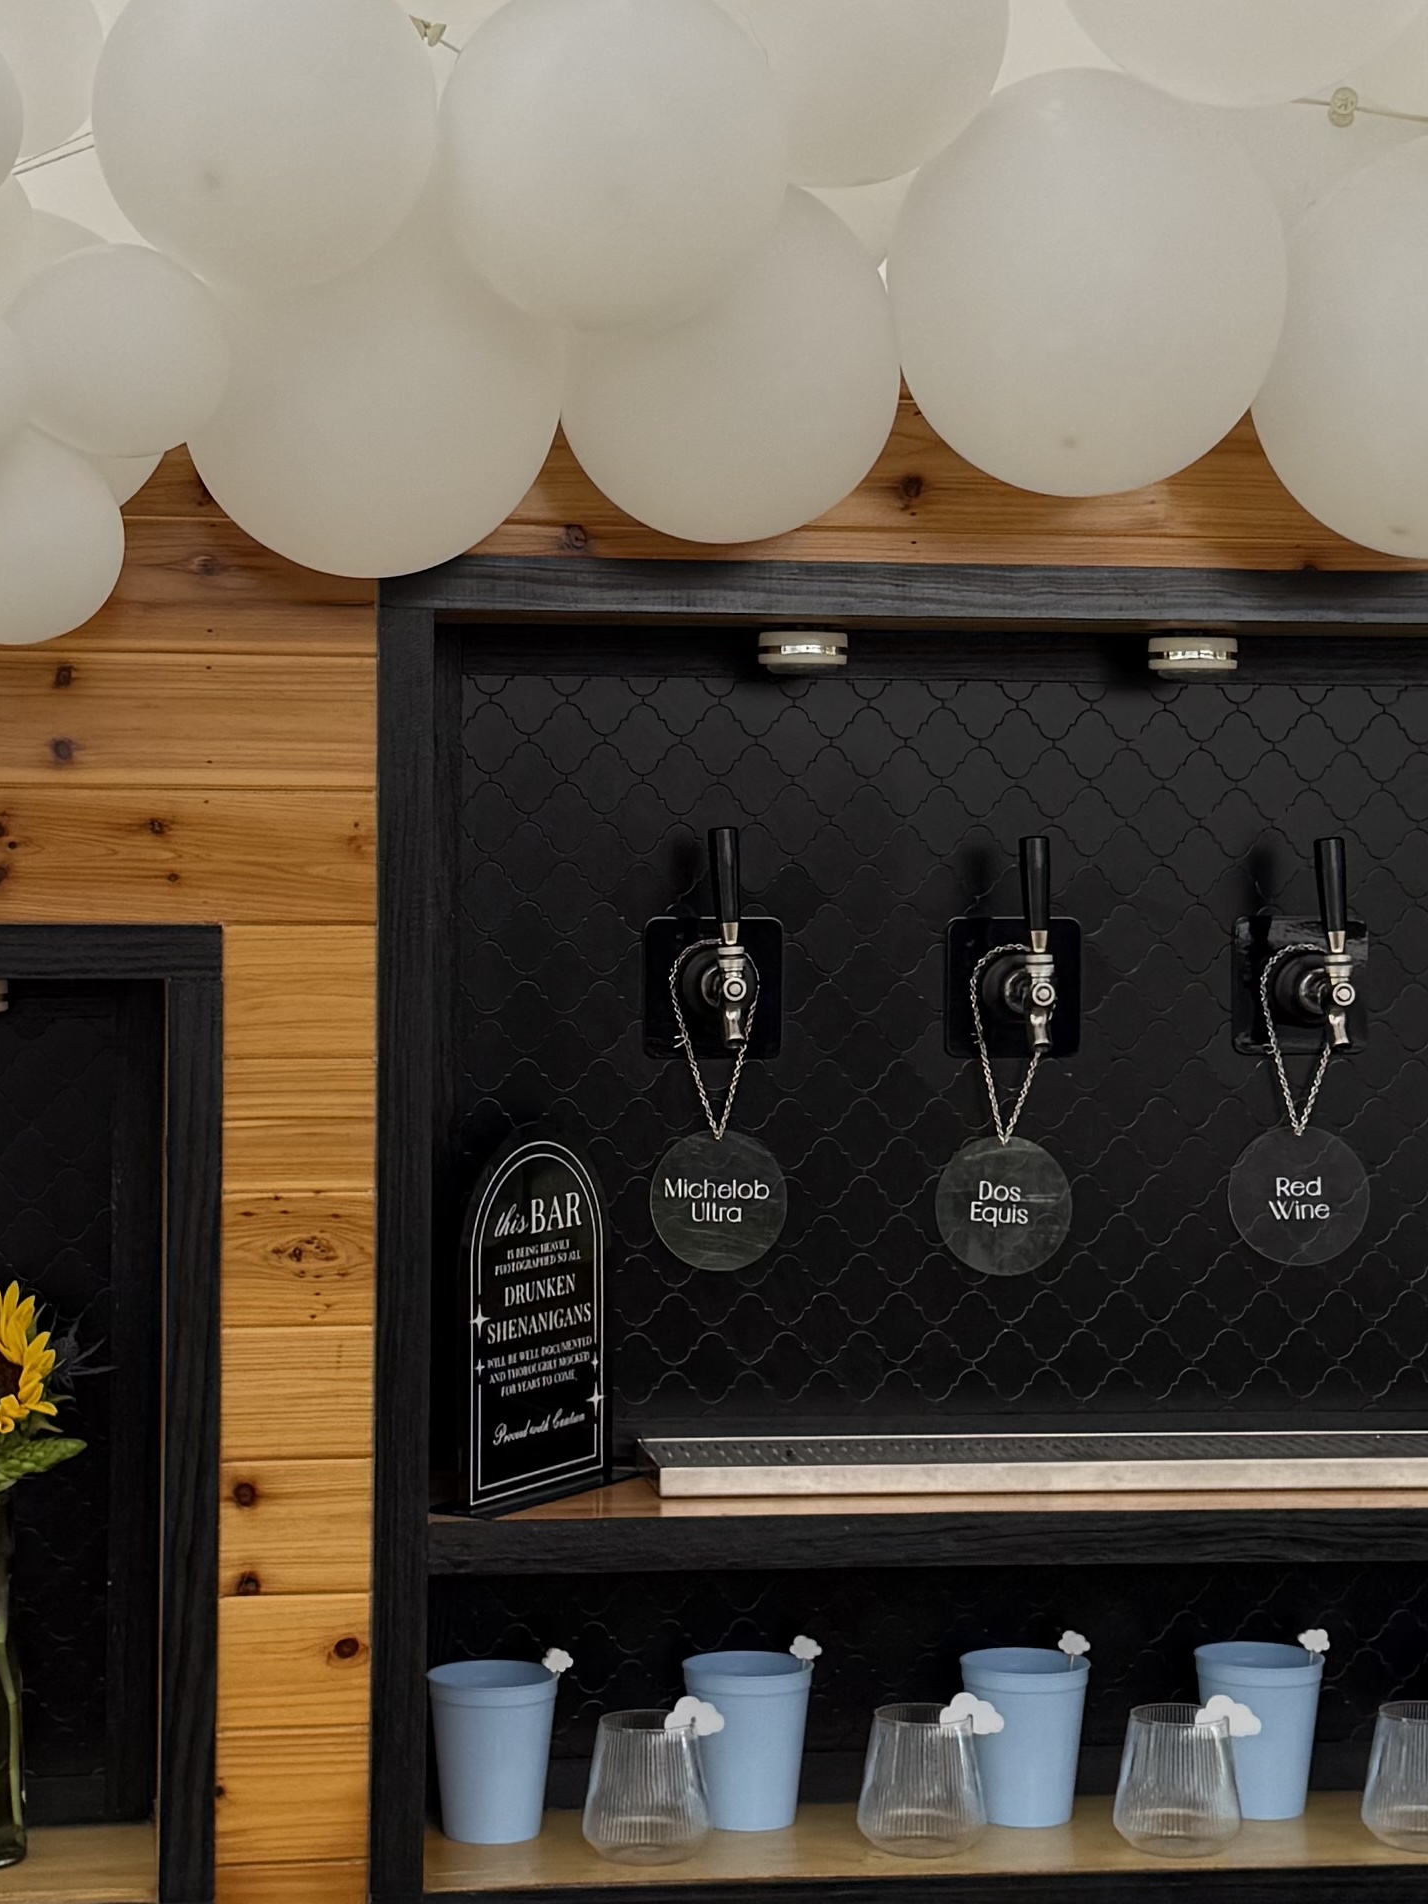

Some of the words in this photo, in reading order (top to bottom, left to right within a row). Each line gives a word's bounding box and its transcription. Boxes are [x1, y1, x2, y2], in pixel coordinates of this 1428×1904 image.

[664, 1178, 770, 1200] Michelob
[978, 1180, 1021, 1202] Dos
[1276, 1176, 1321, 1196] Red
[494, 1203, 529, 1237] this
[531, 1192, 582, 1234] BAR
[691, 1201, 742, 1223] Ultra
[969, 1201, 1029, 1226] Equis
[1269, 1201, 1330, 1220] Wine
[494, 1256, 556, 1276] PHOTOGRAPHED
[504, 1273, 576, 1307] DRUNKEN
[487, 1302, 591, 1344] SHENANIGANS
[487, 1356, 506, 1369] WILL
[508, 1353, 517, 1365] BE
[519, 1348, 539, 1361] WELL
[541, 1335, 592, 1357] DOCUMENTED
[489, 1371, 506, 1384] AND
[507, 1359, 557, 1381] THOROUGHLY
[559, 1351, 590, 1367] MOCKED
[501, 1384, 517, 1398] FOR
[518, 1377, 540, 1393] YEARS
[542, 1376, 553, 1387] TO
